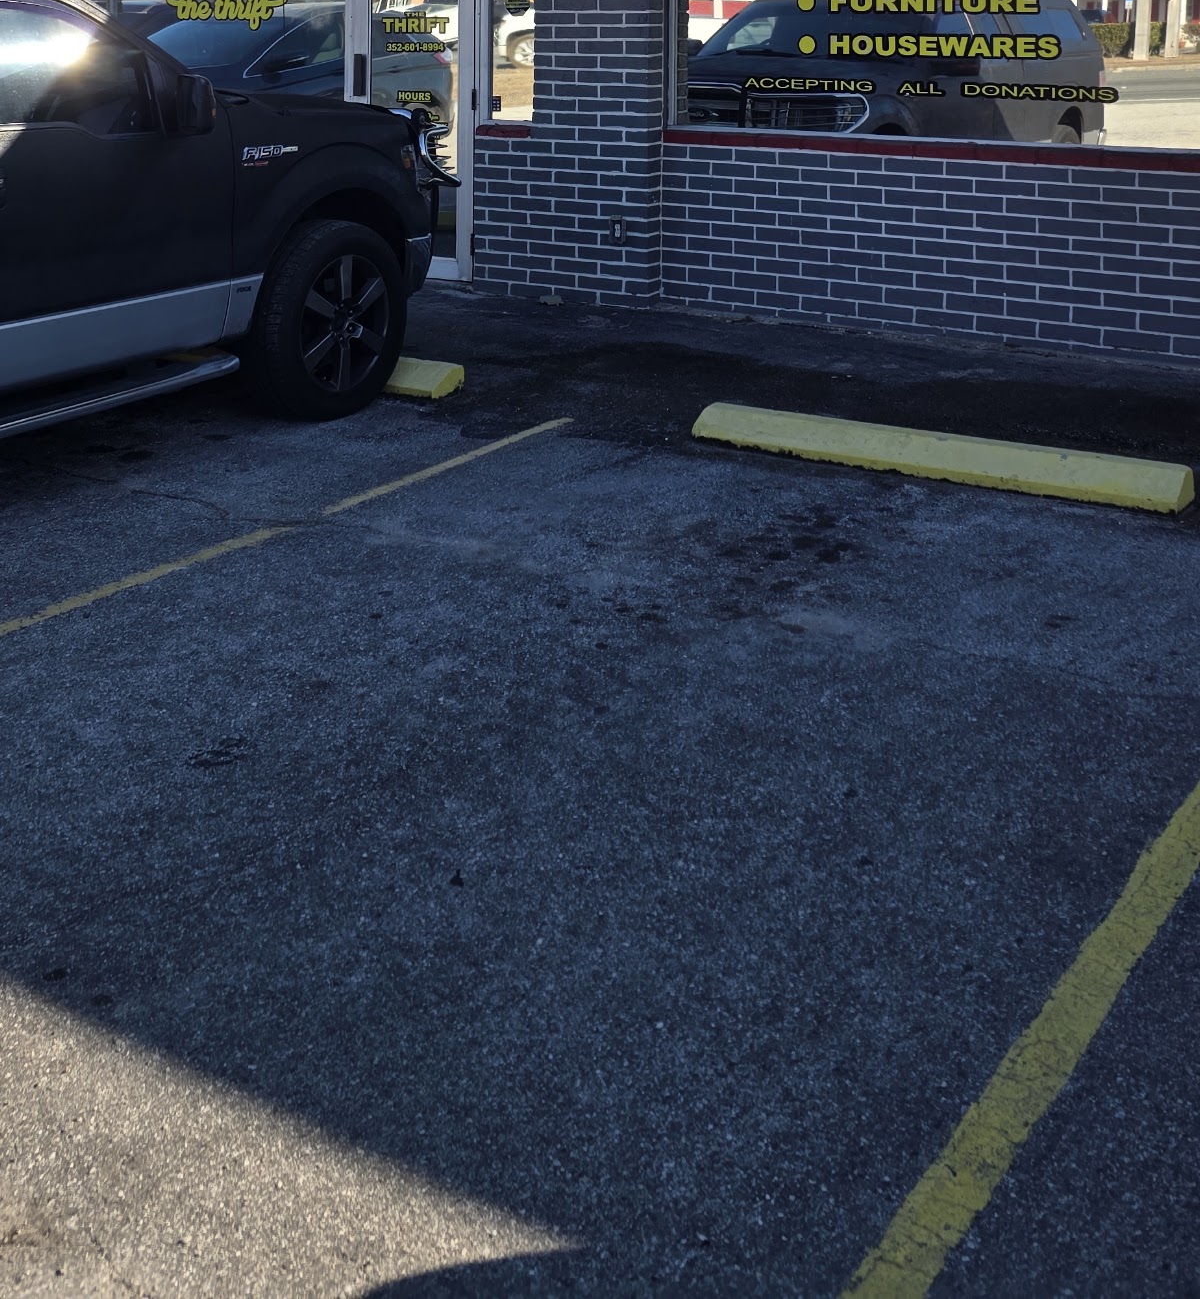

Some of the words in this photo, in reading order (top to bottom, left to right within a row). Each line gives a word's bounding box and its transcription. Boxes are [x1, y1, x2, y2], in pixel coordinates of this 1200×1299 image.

[382, 18, 449, 33] THRIFT
[386, 43, 444, 52] 352-601-8994
[830, 35, 1059, 58] HOUSEWARES
[398, 92, 431, 102] HOURS
[745, 78, 873, 92] ACCEPTING
[900, 83, 942, 95] ALL
[964, 84, 1115, 101] DONATIONS
